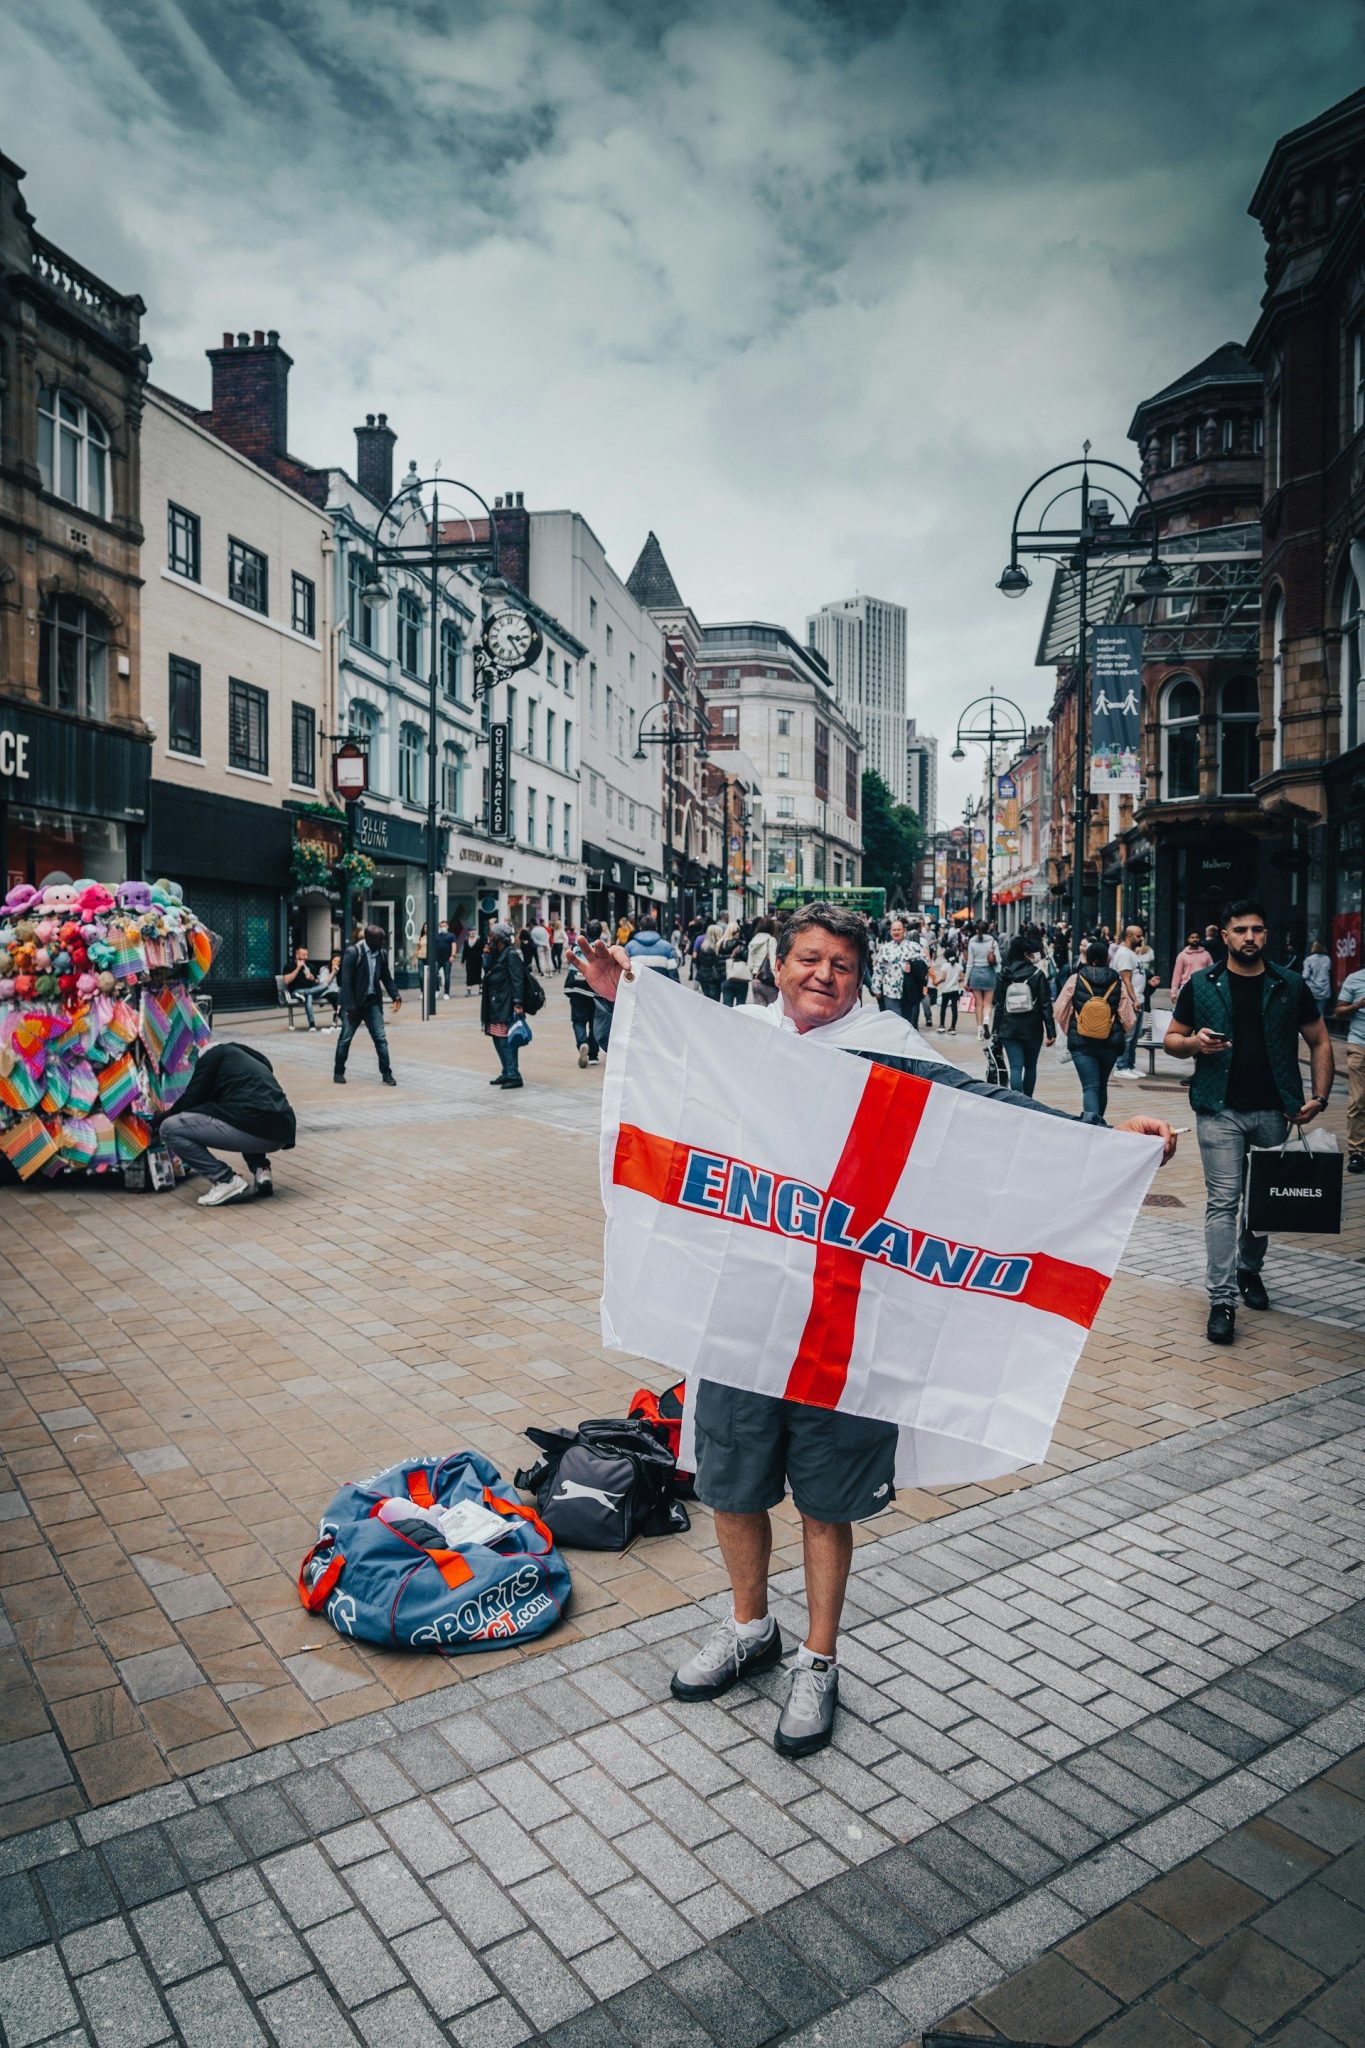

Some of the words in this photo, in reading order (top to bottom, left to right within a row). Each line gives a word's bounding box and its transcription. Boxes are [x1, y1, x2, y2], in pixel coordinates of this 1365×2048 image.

[494, 780, 503, 832] ARCADE
[362, 816, 388, 834] OLLIE
[360, 830, 388, 848] QUINN
[1201, 858, 1232, 870] Mulberry
[1335, 931, 1357, 958] sale
[1269, 1187, 1322, 1198] FLANNELS
[678, 1148, 1033, 1296] ENGLAND
[410, 1564, 539, 1646] SPORTS
